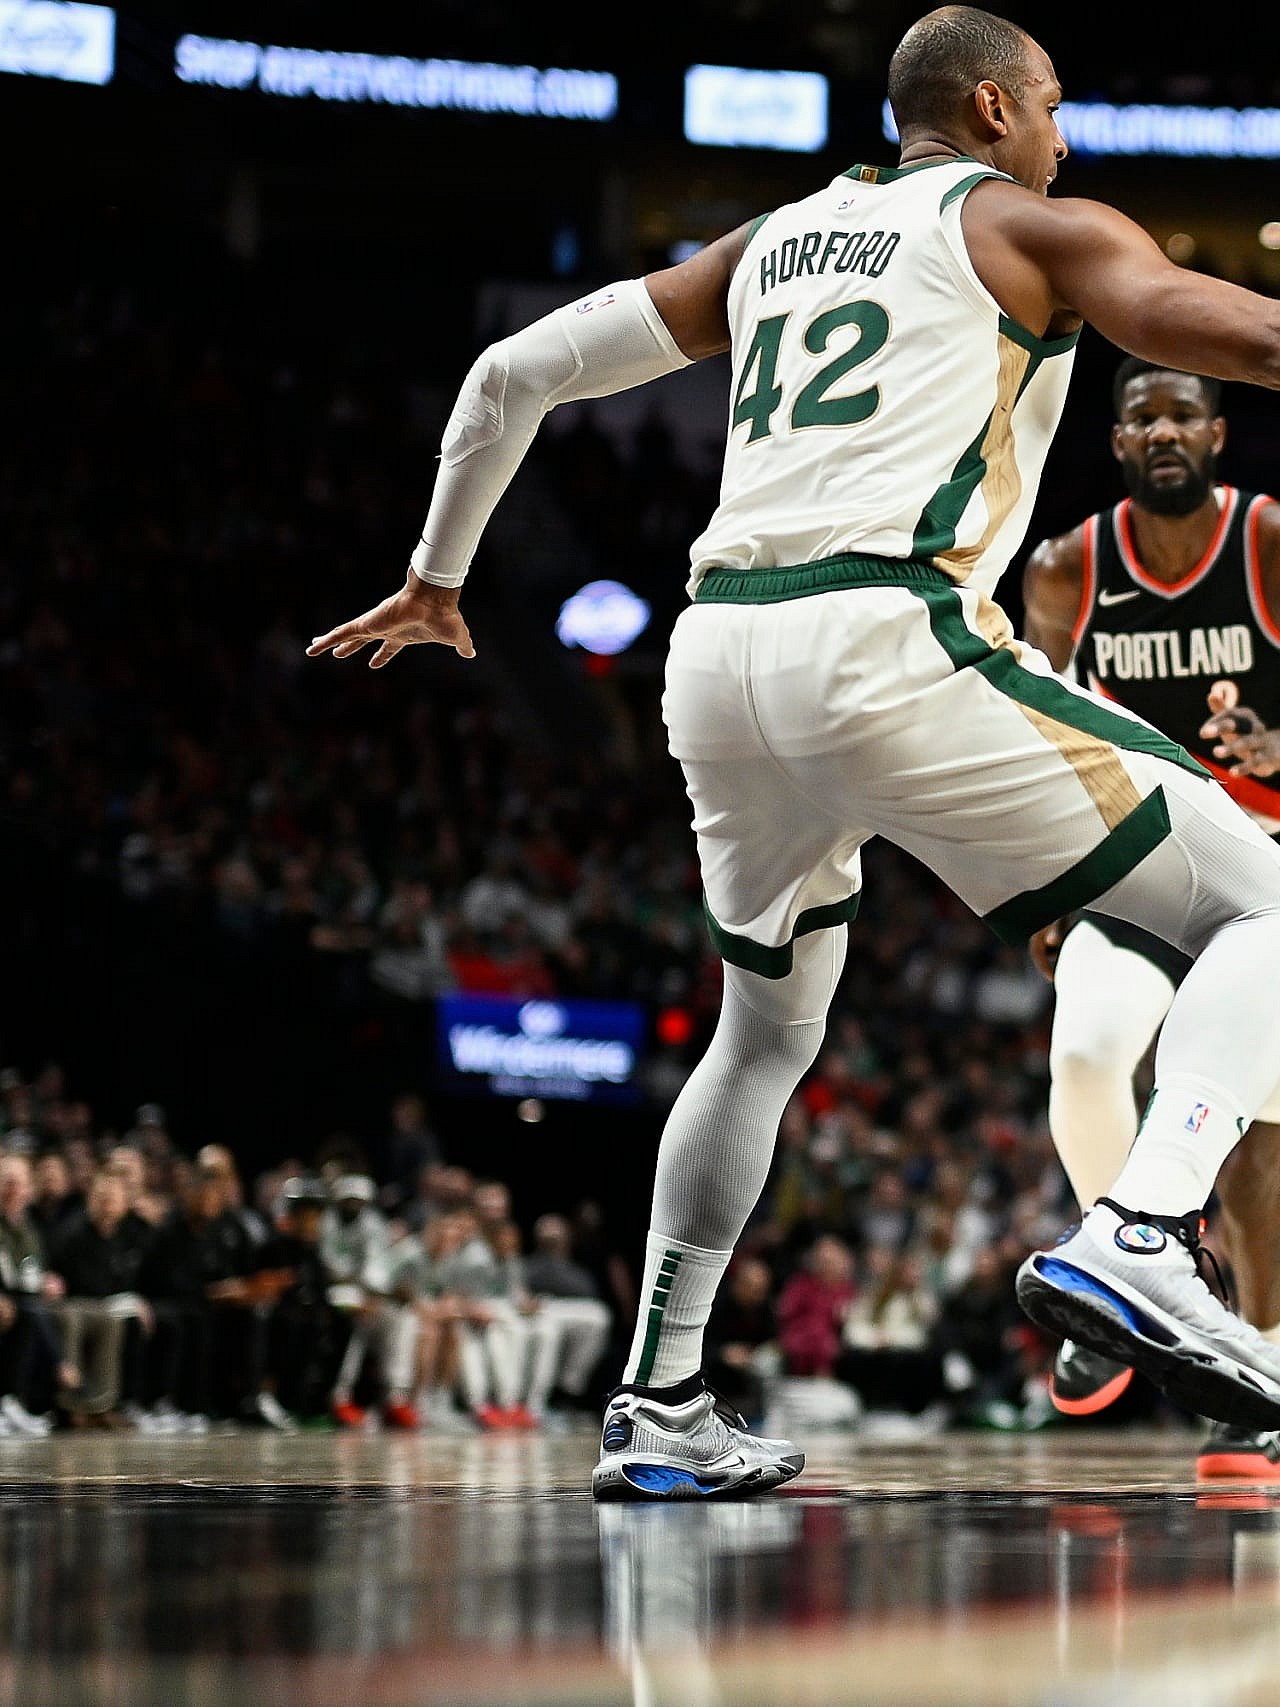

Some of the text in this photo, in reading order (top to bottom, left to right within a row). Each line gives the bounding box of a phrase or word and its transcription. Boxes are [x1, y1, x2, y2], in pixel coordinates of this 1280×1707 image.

[761, 231, 900, 296] HORFORD
[731, 297, 892, 449] 42
[1092, 625, 1253, 679] PORTLAND
